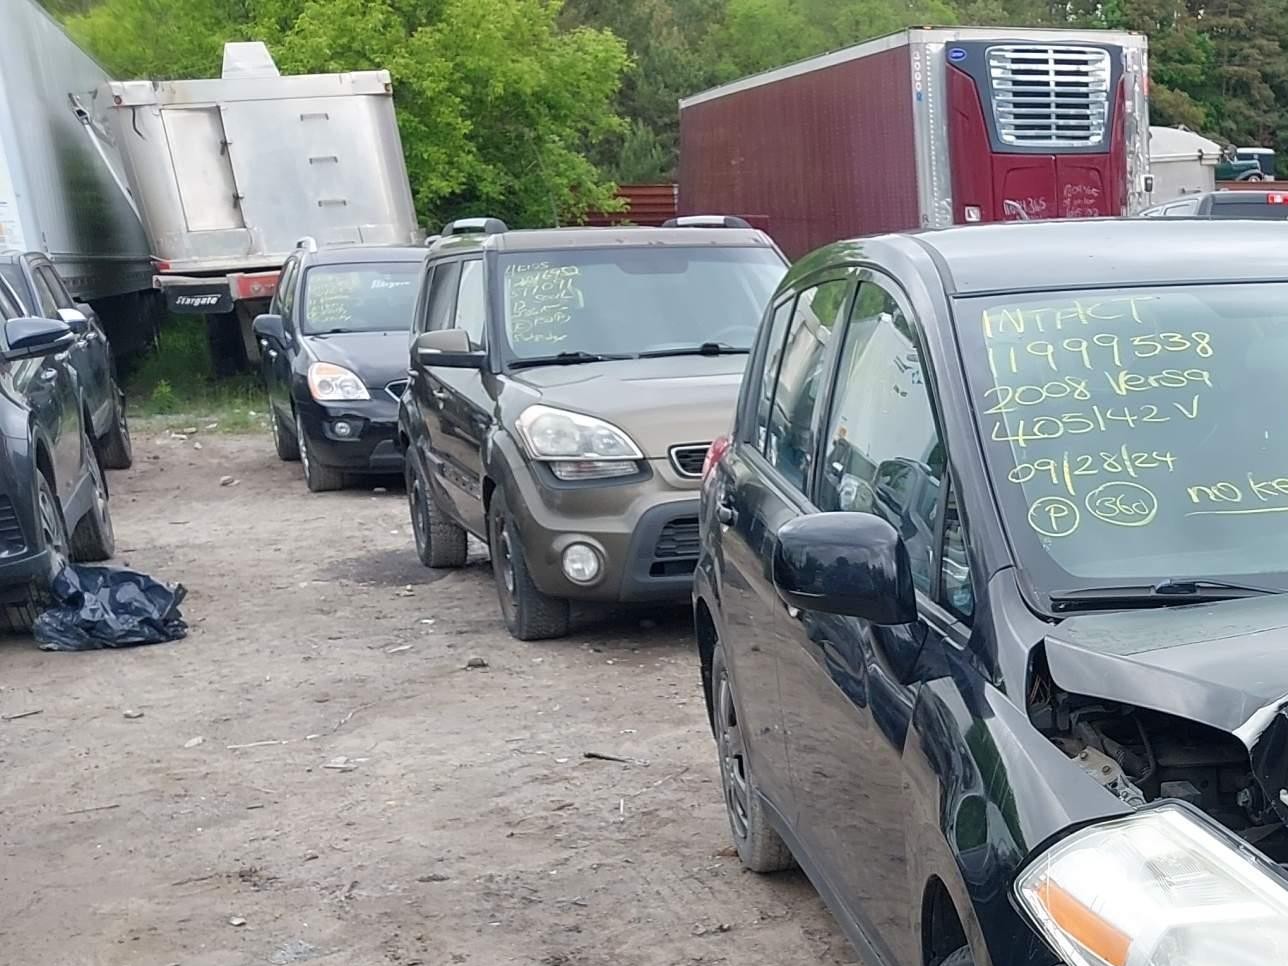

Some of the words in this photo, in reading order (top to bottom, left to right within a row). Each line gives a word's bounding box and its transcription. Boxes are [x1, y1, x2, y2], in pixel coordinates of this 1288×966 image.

[983, 296, 1154, 338] INTACT
[988, 331, 1214, 378] 11999538
[983, 375, 1091, 414] 2008
[1008, 444, 1176, 496] 09/28/24
